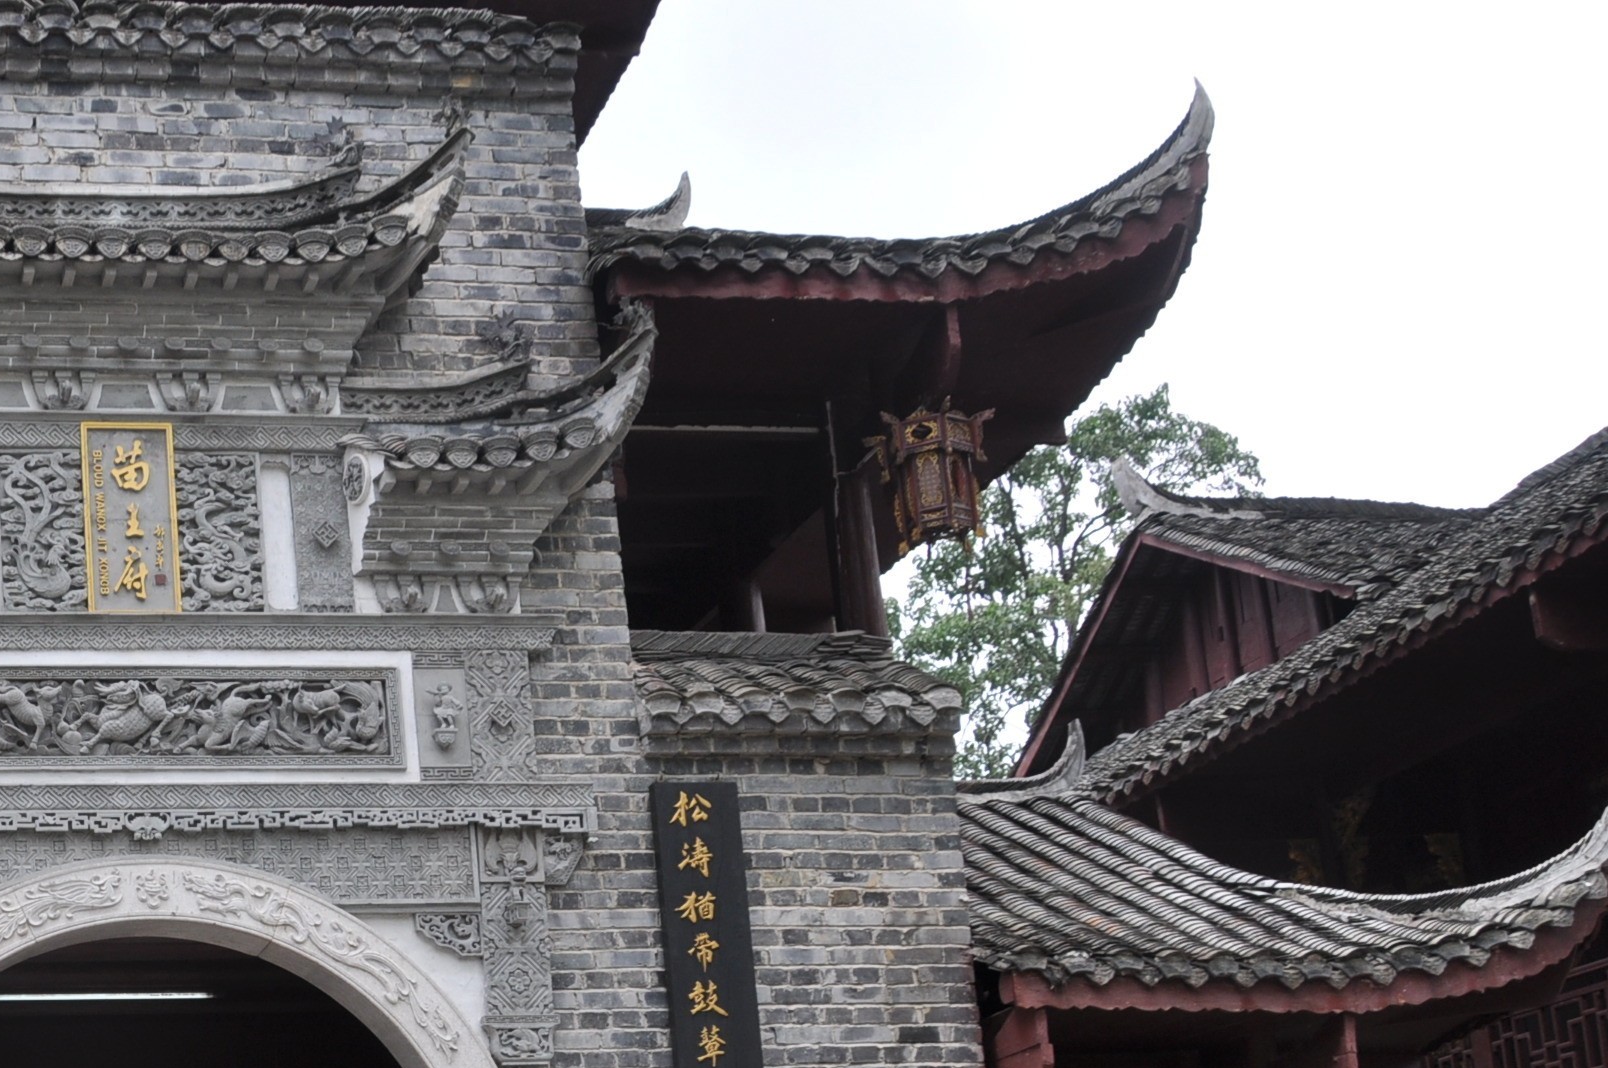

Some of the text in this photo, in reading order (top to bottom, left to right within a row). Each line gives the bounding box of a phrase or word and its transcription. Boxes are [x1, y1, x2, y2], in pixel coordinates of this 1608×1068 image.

[92, 450, 111, 595] BLOUD WANGX JIT XONGB
[110, 440, 150, 600] 苗王府
